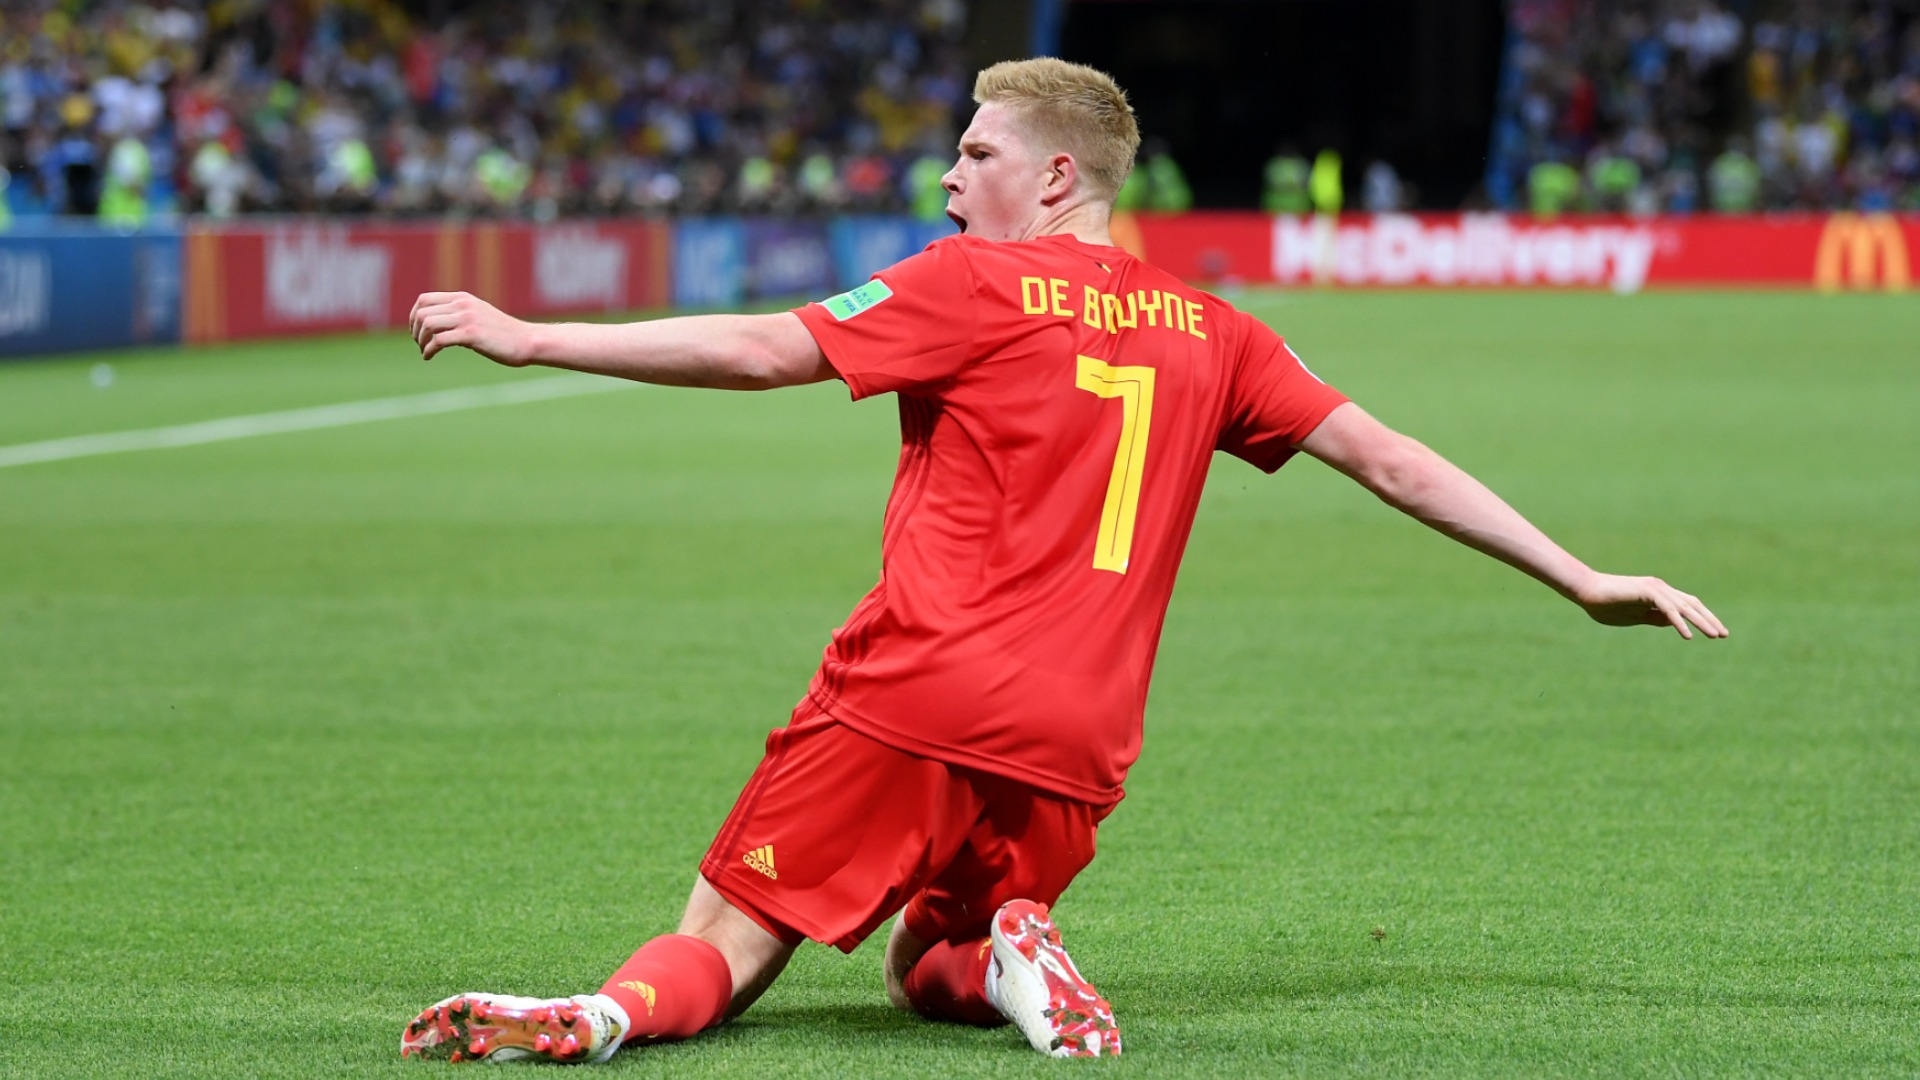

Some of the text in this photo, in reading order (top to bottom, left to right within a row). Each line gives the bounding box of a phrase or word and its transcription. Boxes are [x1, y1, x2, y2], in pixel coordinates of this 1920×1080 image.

[1272, 212, 1653, 292] McDelivery
[842, 299, 856, 313] FIFA
[1021, 276, 1206, 340] DE BRUYNE
[1075, 354, 1156, 575] 7
[742, 854, 778, 880] adidas
